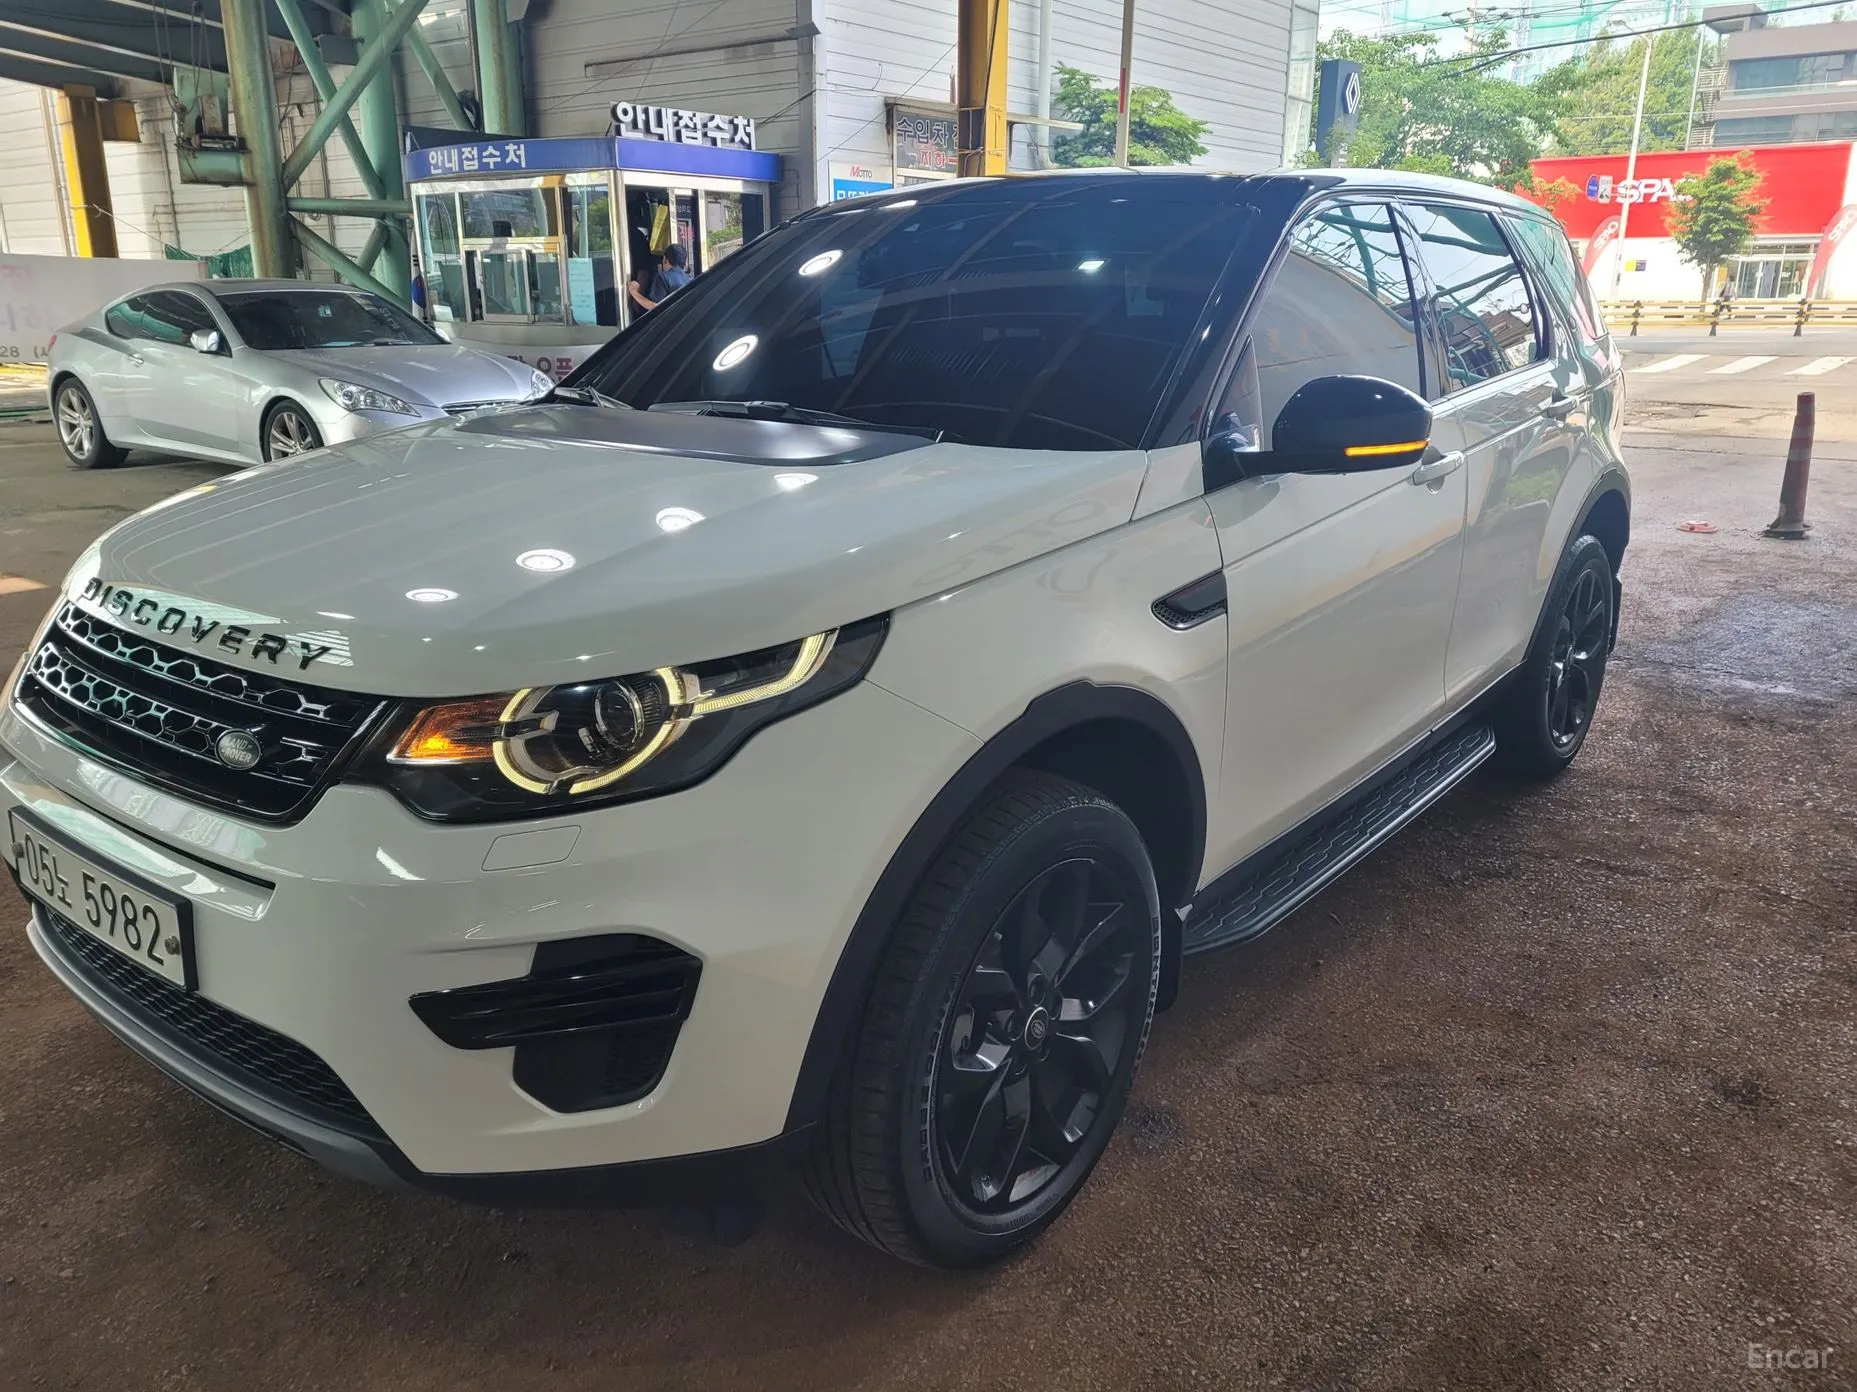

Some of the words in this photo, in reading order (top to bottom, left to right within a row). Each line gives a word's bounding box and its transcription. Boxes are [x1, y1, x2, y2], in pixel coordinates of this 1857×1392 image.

[613, 101, 756, 151] 안내접수처
[428, 142, 527, 174] 안내접수처
[80, 577, 333, 670] DISCOVERY
[224, 748, 252, 762] ROVER
[24, 832, 72, 909] 05노
[82, 869, 164, 966] 5982
